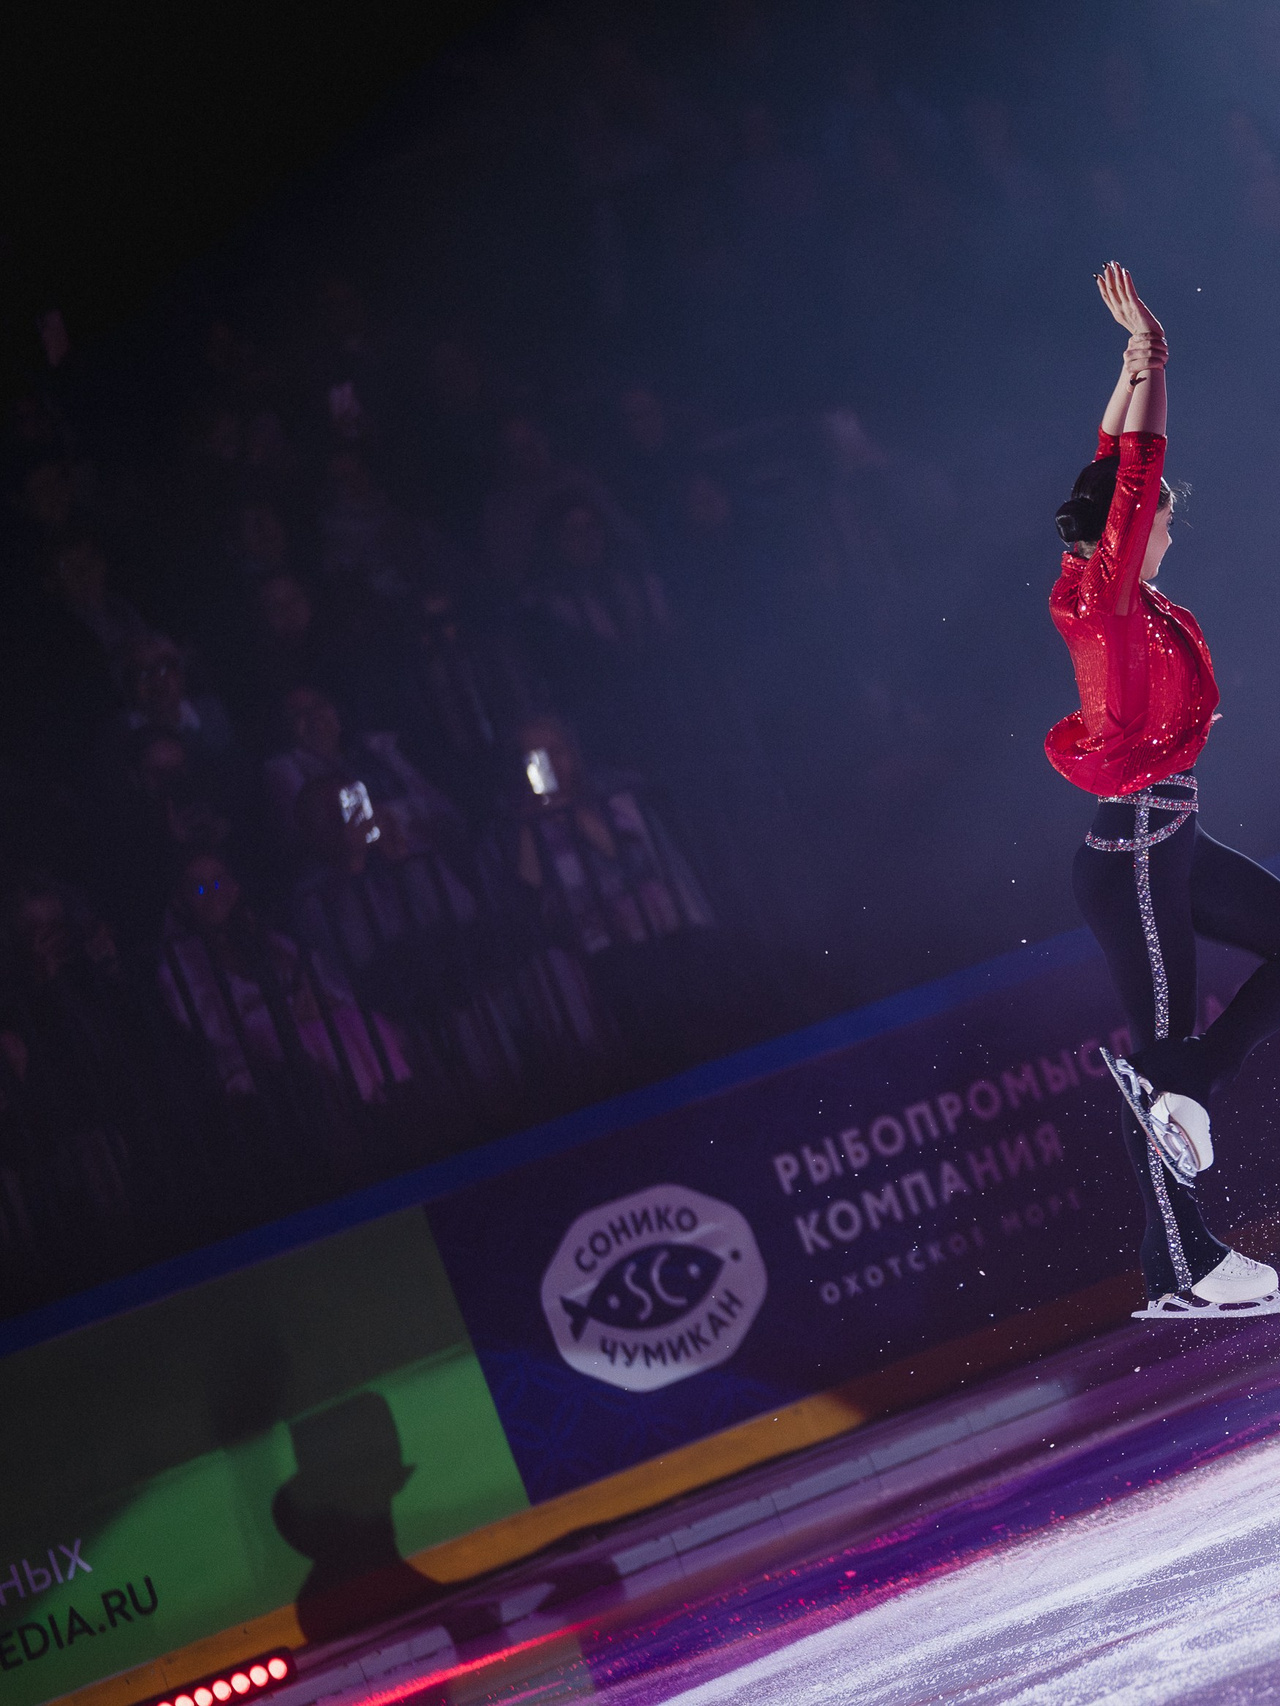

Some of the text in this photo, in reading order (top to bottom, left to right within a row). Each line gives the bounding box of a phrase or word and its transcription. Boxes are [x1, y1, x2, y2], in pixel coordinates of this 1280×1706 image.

[772, 995, 1224, 1195] РЫБОПРОМЫСЛ
[574, 1206, 698, 1273] СОНИКО
[794, 1121, 1064, 1255] КОМПАНИЯ
[600, 1288, 744, 1368] ЧУМИКАН
